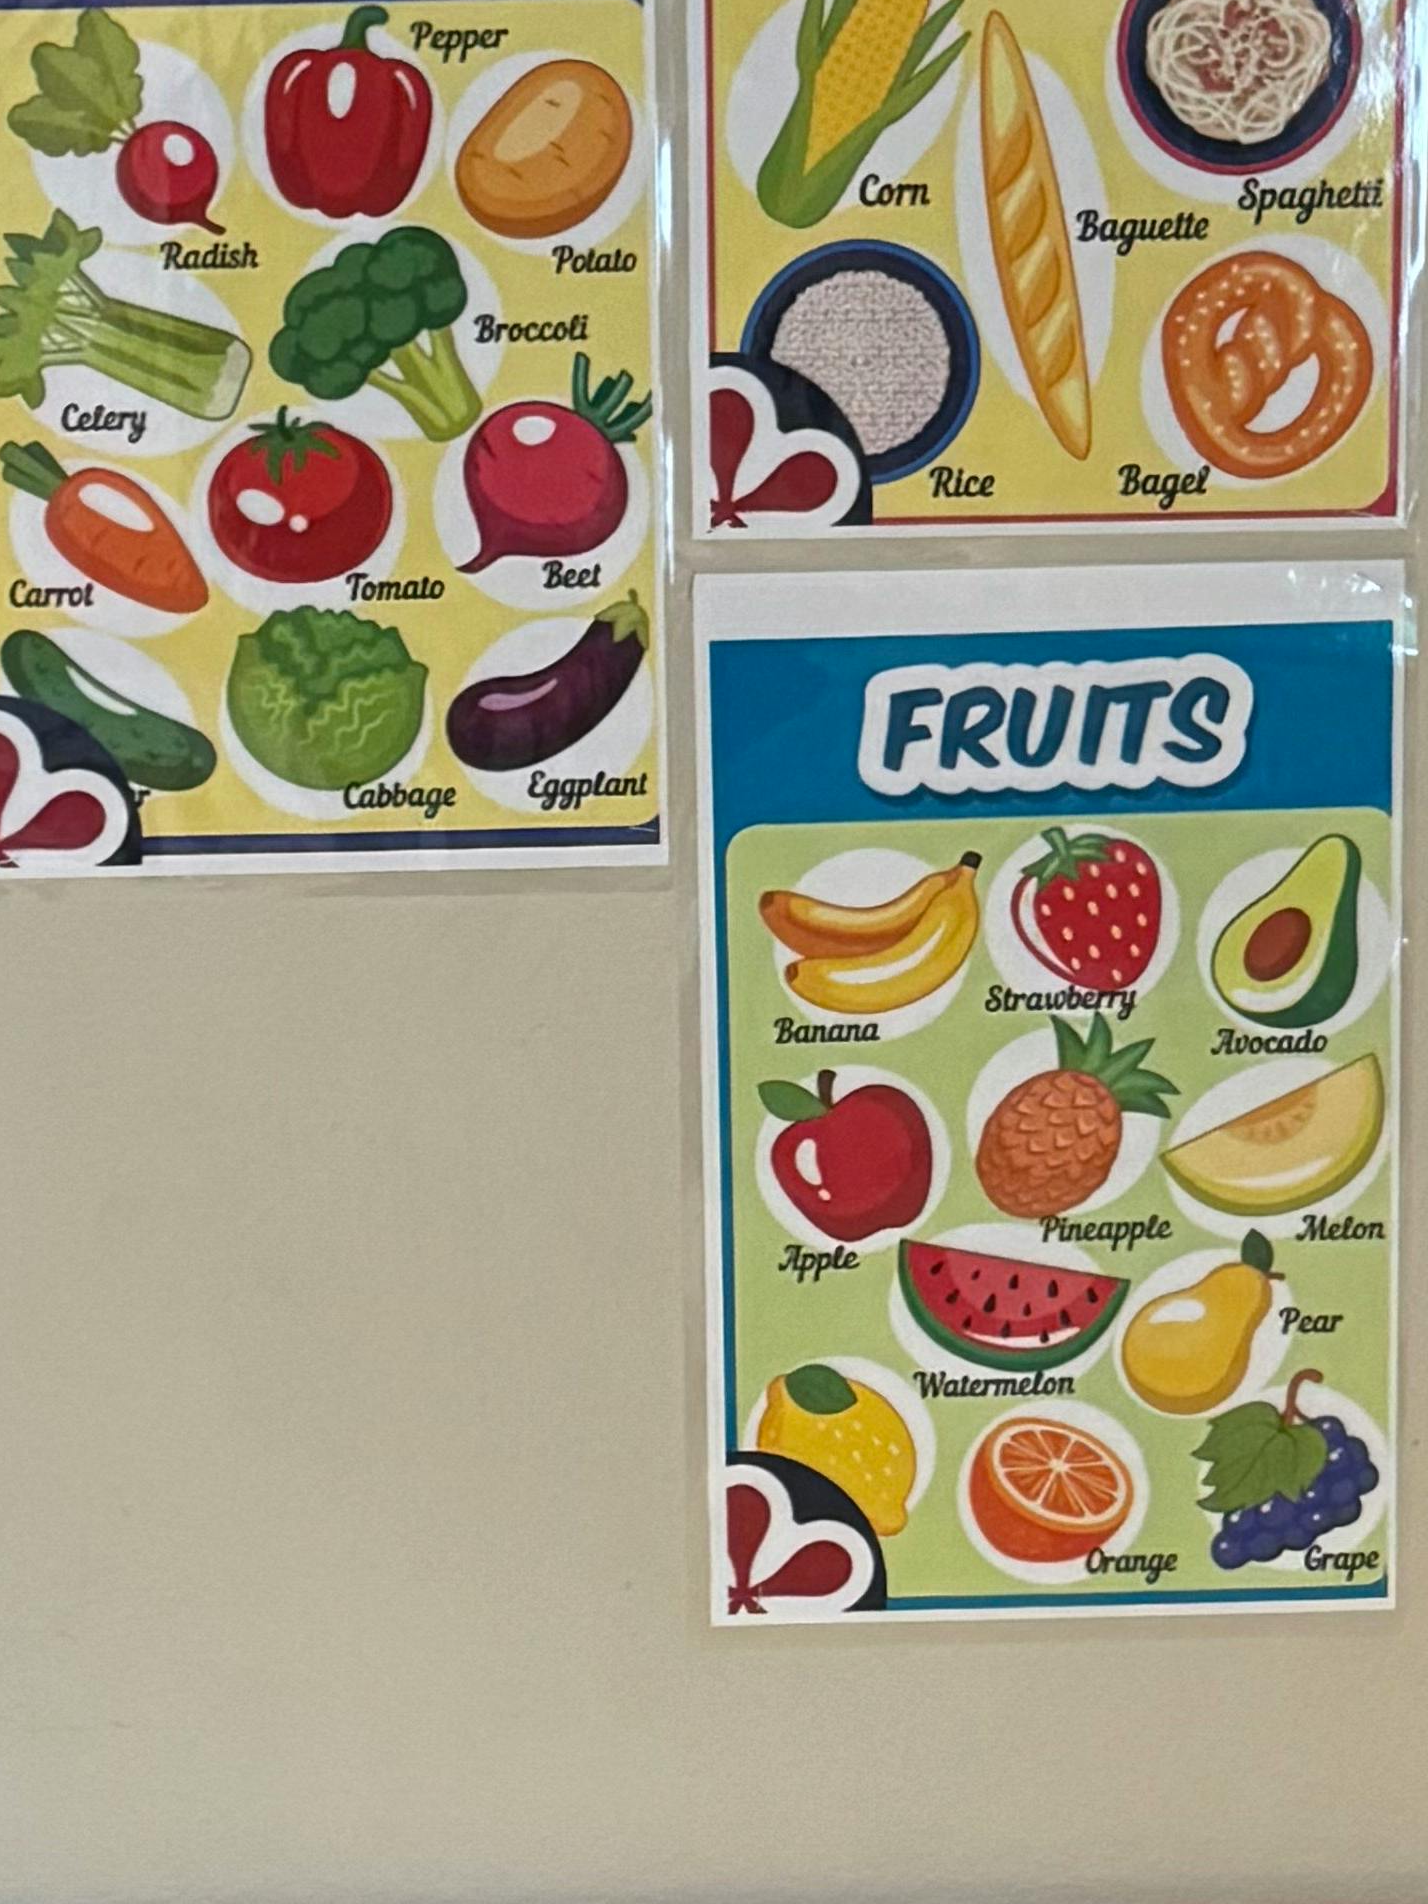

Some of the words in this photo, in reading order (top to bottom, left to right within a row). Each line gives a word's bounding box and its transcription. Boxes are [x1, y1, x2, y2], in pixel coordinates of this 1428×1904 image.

[410, 22, 508, 62] Pepper
[858, 175, 930, 207] Corn
[1237, 178, 1383, 224] Spaghetti
[1076, 210, 1208, 255] Baguette
[160, 242, 259, 271] Radish
[552, 245, 636, 274] Potato
[473, 313, 589, 344] Broccoli
[61, 404, 146, 444] Celery
[930, 467, 994, 498] Rice
[1119, 464, 1209, 508] Bagel
[344, 574, 444, 602] Tomato
[543, 561, 601, 590] Beet
[9, 579, 94, 608] Carrot
[882, 676, 1230, 772] FRUITS
[343, 782, 456, 819] Cabbage
[527, 772, 648, 806] Eggplant
[984, 985, 1136, 1021] Strawberry
[773, 1017, 880, 1046] Banana
[1210, 1027, 1328, 1057] Avocado
[1040, 1215, 1172, 1250] Pineapple
[1295, 1214, 1384, 1244] Melon
[778, 1244, 860, 1283] Apple
[1279, 1307, 1344, 1335] Pear
[913, 1371, 1075, 1399] Watermelon
[1086, 1547, 1178, 1585] Orange
[1303, 1545, 1380, 1581] Grape
